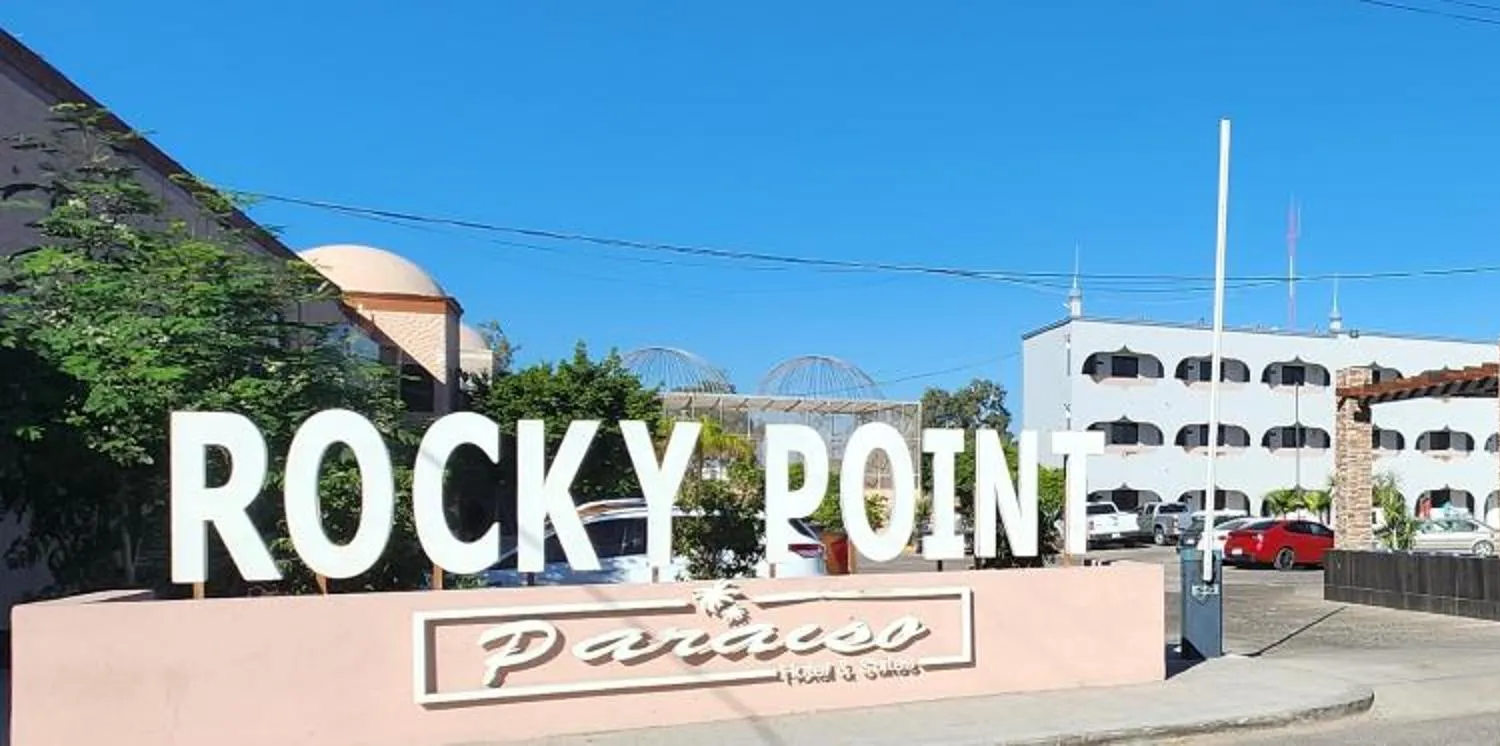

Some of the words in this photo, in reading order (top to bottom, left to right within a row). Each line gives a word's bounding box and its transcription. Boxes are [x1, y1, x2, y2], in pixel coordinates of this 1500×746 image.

[170, 408, 701, 583] ROCKY
[765, 421, 1105, 563] POINT
[477, 611, 929, 688] Paraiso
[775, 662, 835, 686] Hotel
[861, 655, 921, 680] Suites
